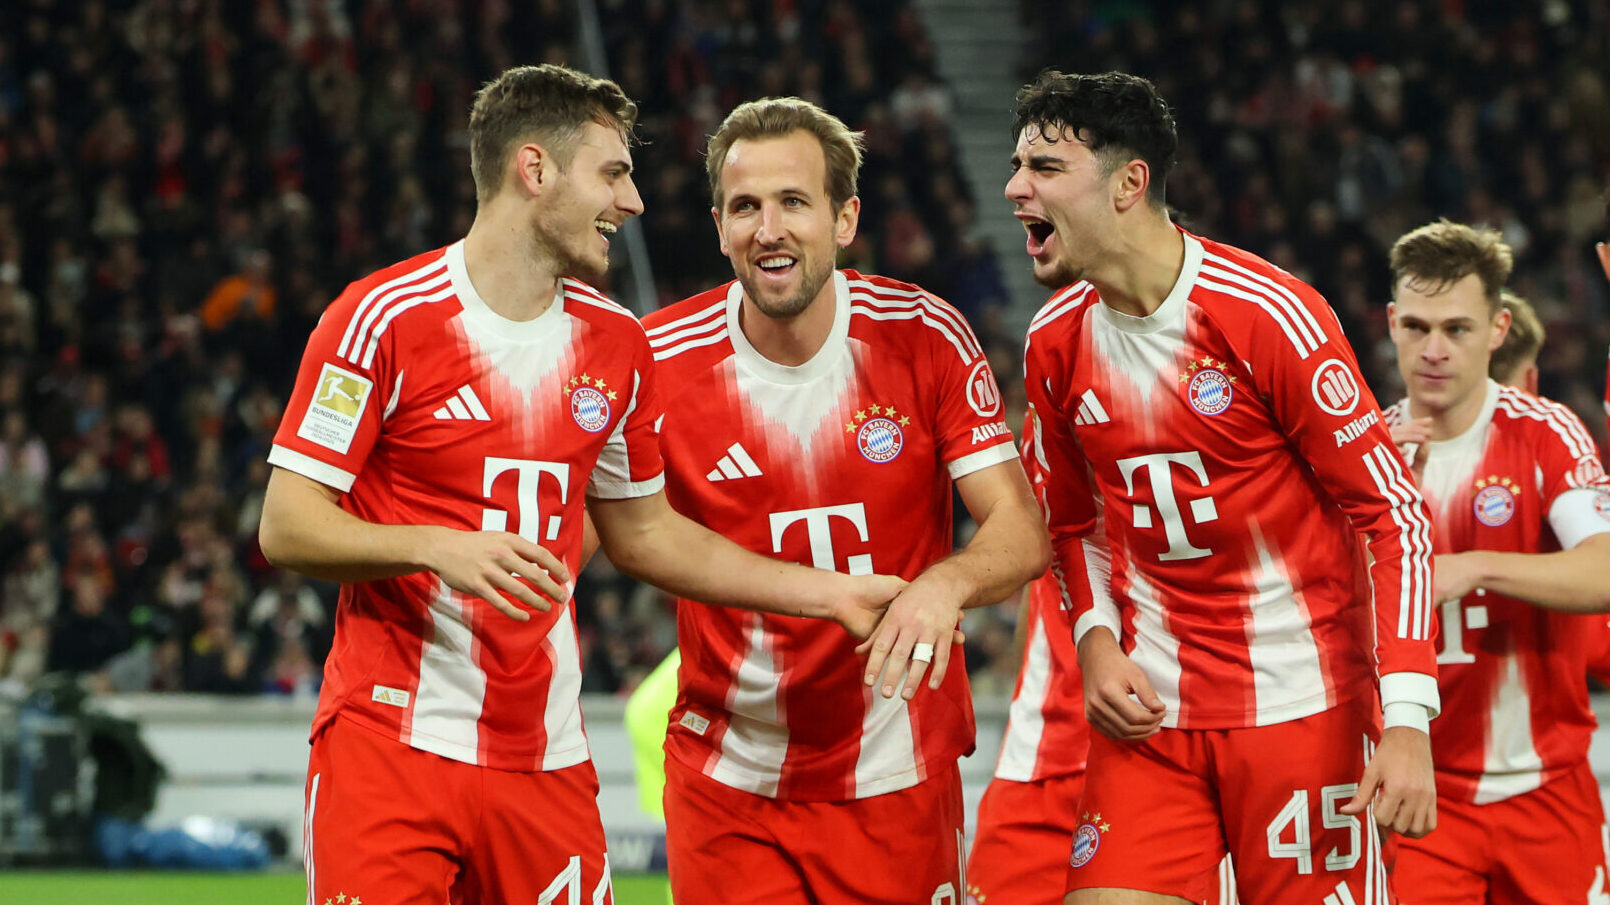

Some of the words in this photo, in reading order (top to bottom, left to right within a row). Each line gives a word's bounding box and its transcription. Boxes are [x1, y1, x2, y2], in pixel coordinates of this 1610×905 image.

[1199, 372, 1228, 389] BAYERN
[579, 390, 606, 408] BAYERN
[312, 406, 353, 426] BUNDESLIGA
[868, 420, 899, 437] BAYERN
[1333, 409, 1379, 448] Allianz
[1266, 783, 1362, 875] 45
